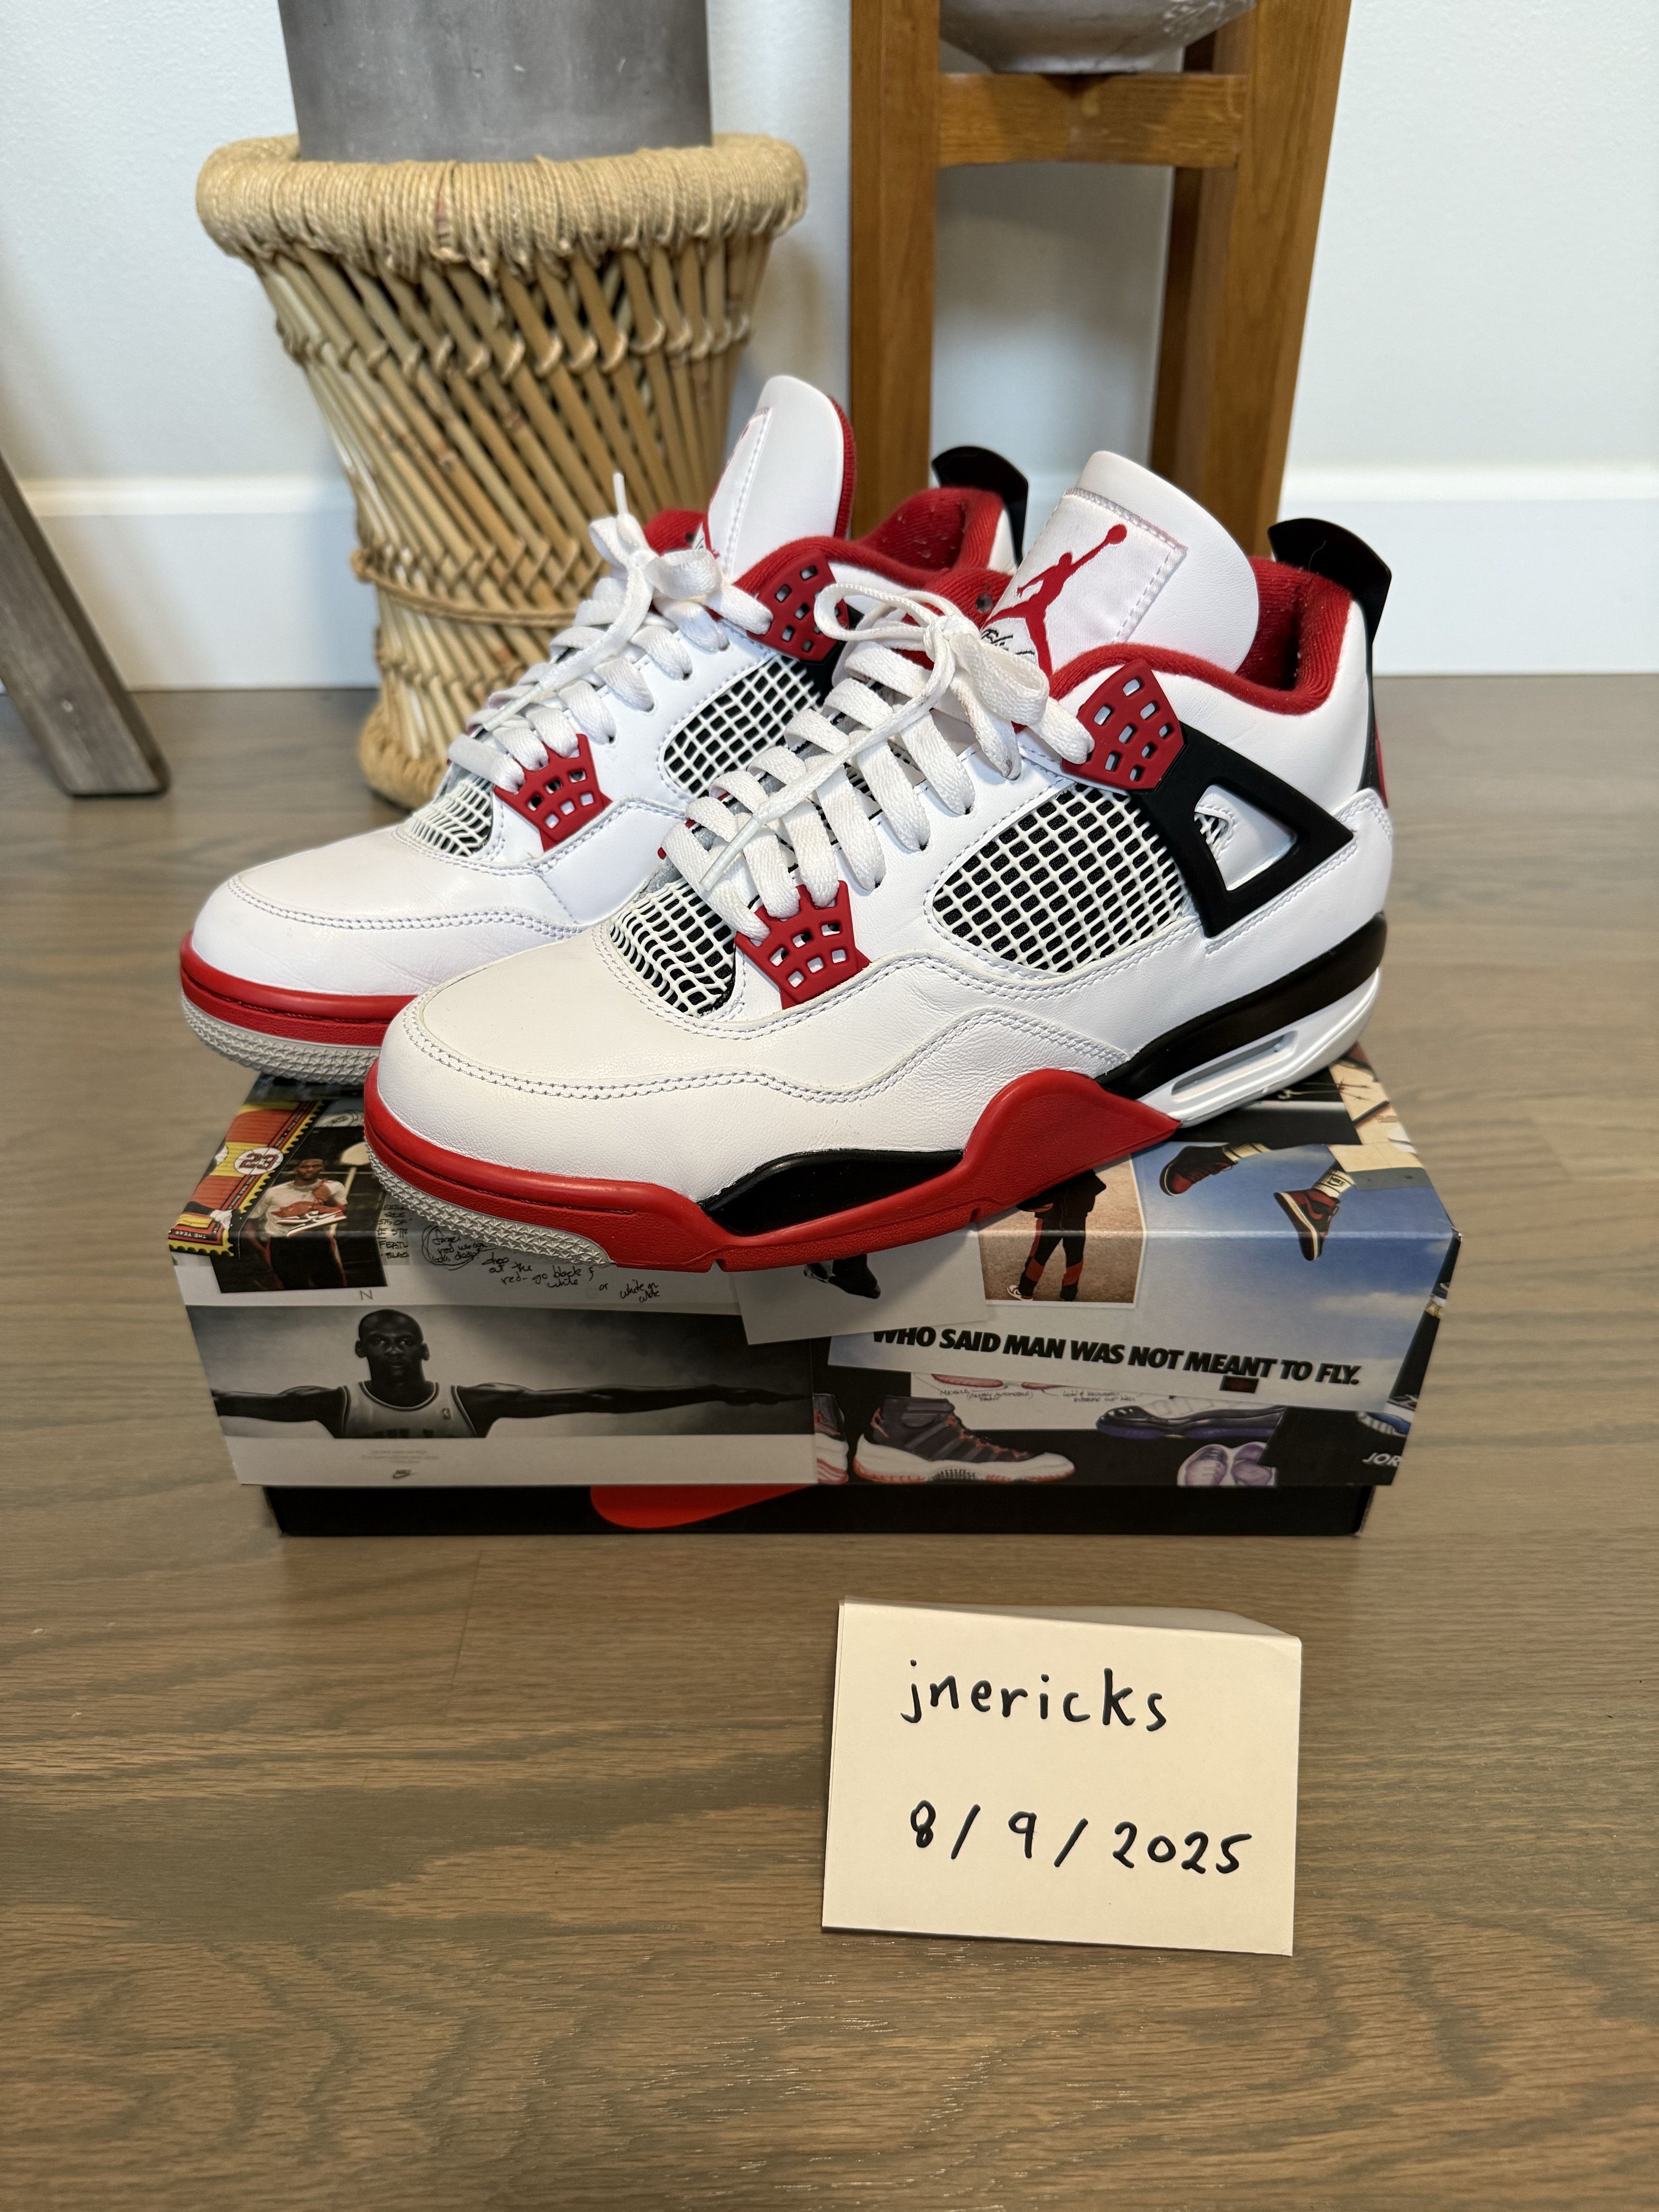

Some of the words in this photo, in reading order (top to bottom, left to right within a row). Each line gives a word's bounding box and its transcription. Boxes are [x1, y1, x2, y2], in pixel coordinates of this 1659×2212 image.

[239, 1153, 279, 1170] 23
[532, 1273, 548, 1284] go
[553, 1265, 582, 1278] black
[547, 1277, 579, 1288] white
[599, 1283, 609, 1291] or
[620, 1279, 644, 1299] white
[874, 1327, 936, 1347] WHO
[939, 1329, 1001, 1353] SAID
[1002, 1334, 1066, 1359] MAN
[1070, 1340, 1126, 1364] WAS
[1128, 1346, 1185, 1370] NOT
[1183, 1351, 1278, 1378] MEANT
[1280, 1359, 1313, 1381] TO
[1314, 1362, 1362, 1385] FLY.
[900, 1659, 1168, 1732] jnericks
